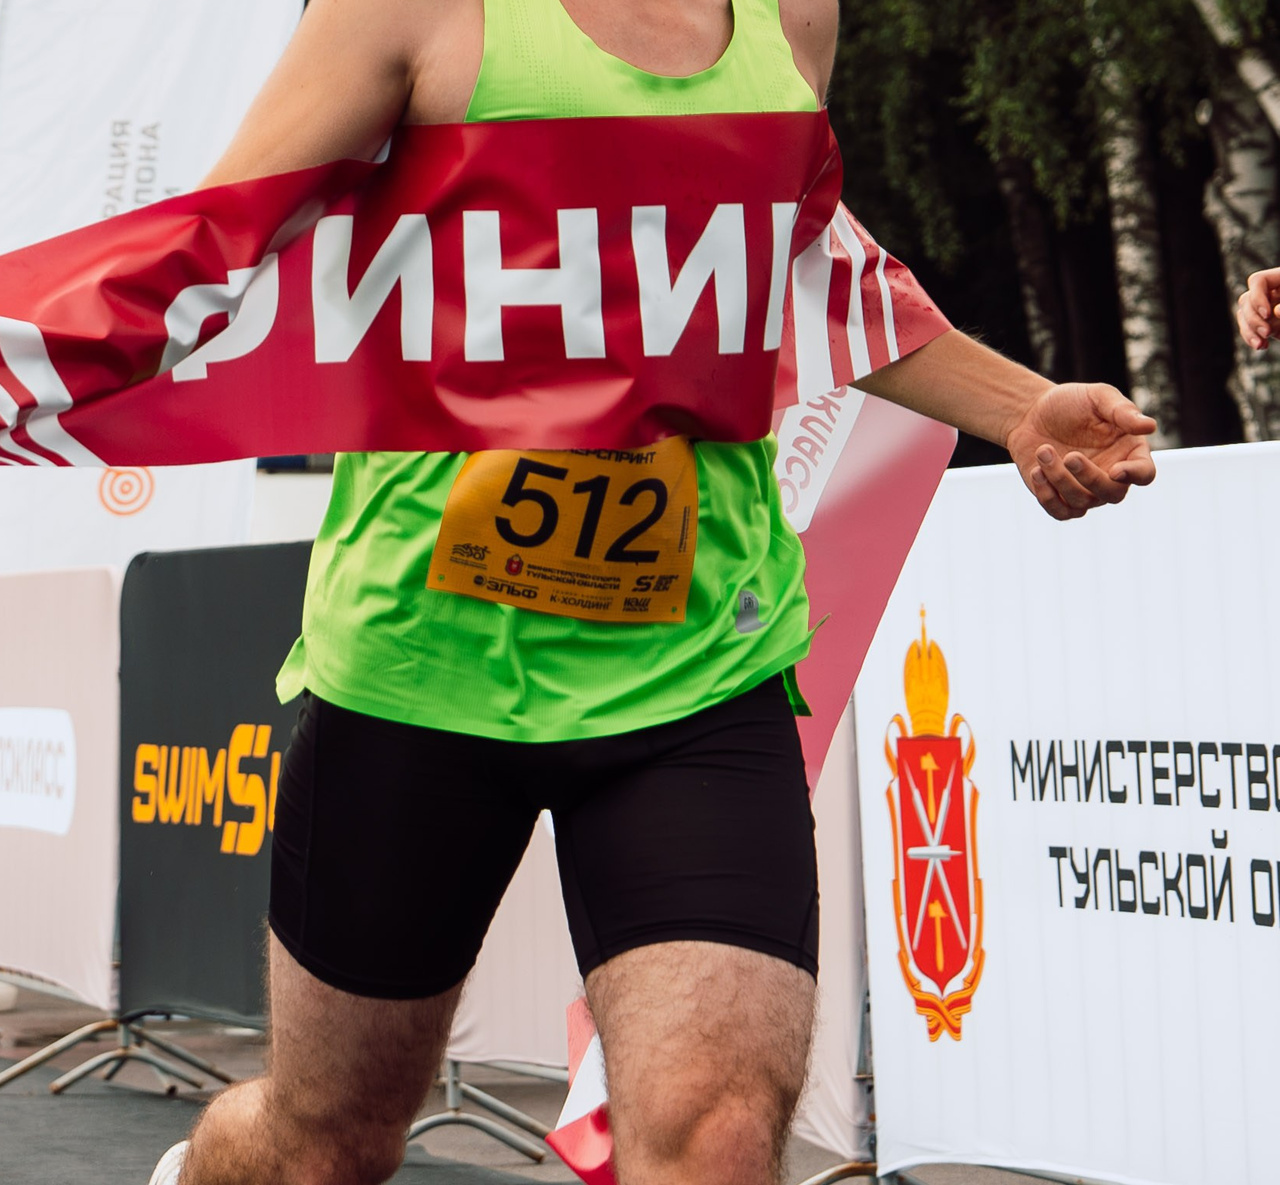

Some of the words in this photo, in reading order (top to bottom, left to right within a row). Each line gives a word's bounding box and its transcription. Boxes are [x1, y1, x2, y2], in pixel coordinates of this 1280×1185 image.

[494, 457, 669, 564] 512
[486, 579, 538, 599] ЭЛЬФ
[1048, 828, 1235, 923] ТУЛЬСКОЙ
